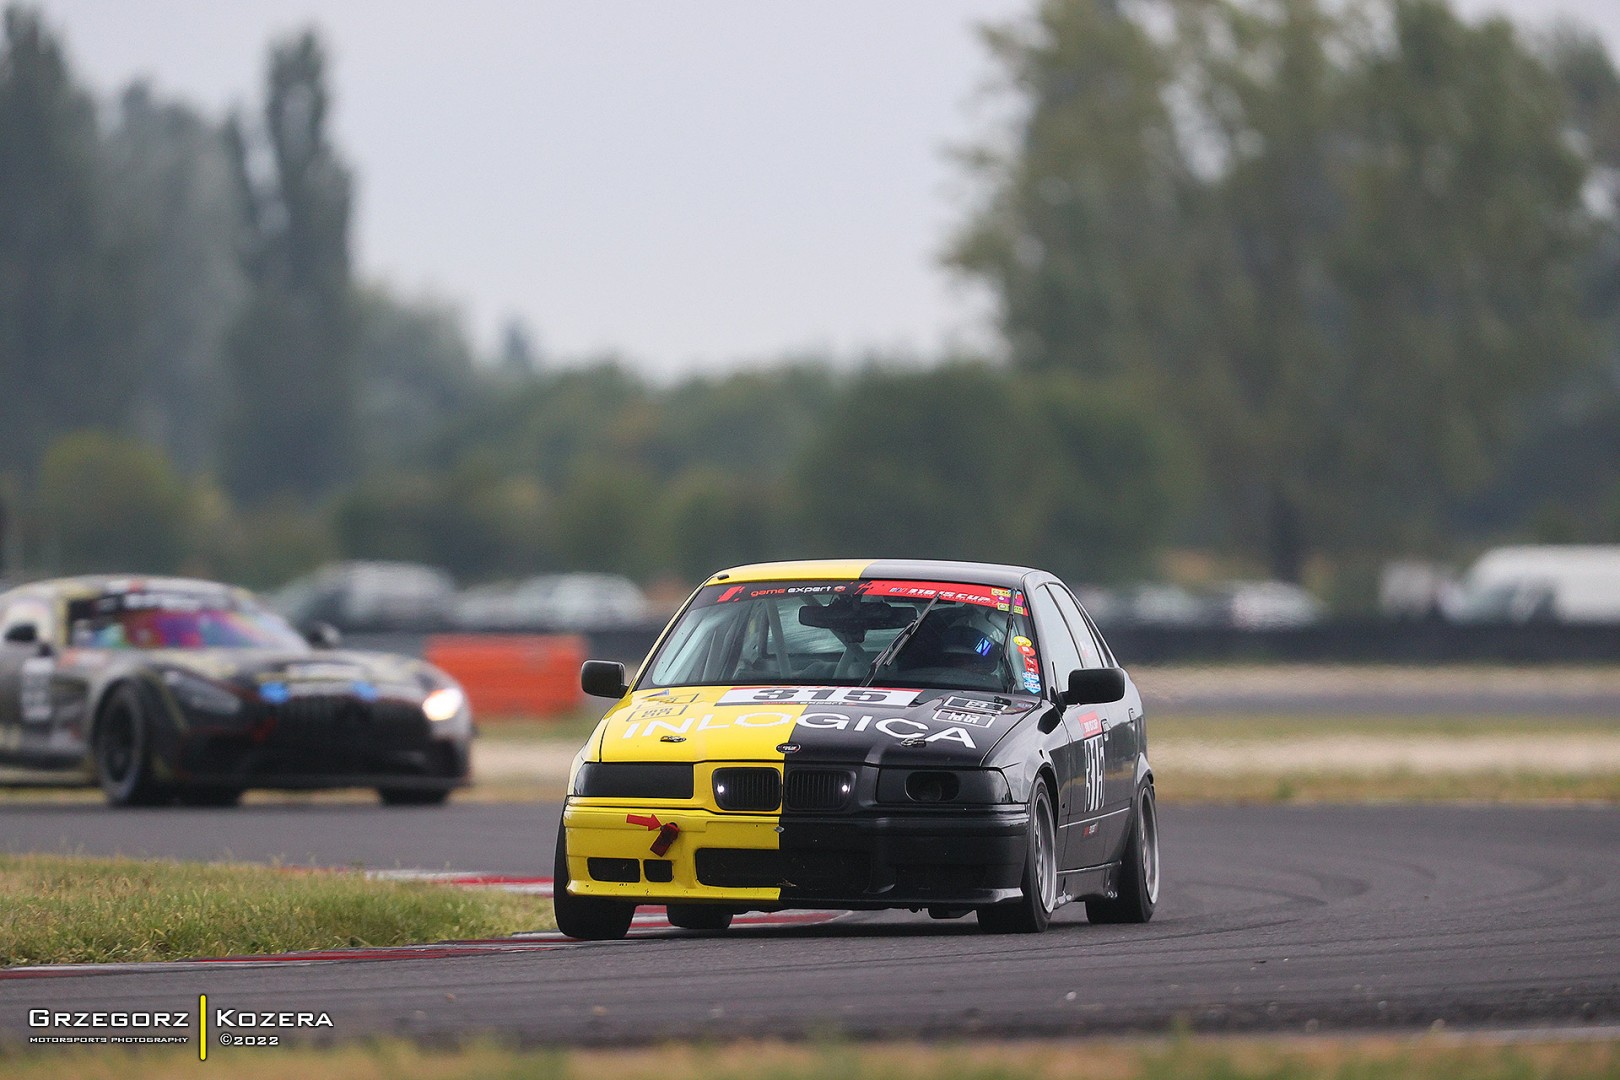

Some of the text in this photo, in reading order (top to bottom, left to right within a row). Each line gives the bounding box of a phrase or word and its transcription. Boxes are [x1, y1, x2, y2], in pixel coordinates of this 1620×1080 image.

[750, 585, 832, 598] game expert
[753, 689, 892, 701] 315
[622, 712, 977, 749] INLOGICA
[1085, 736, 1105, 812] 315
